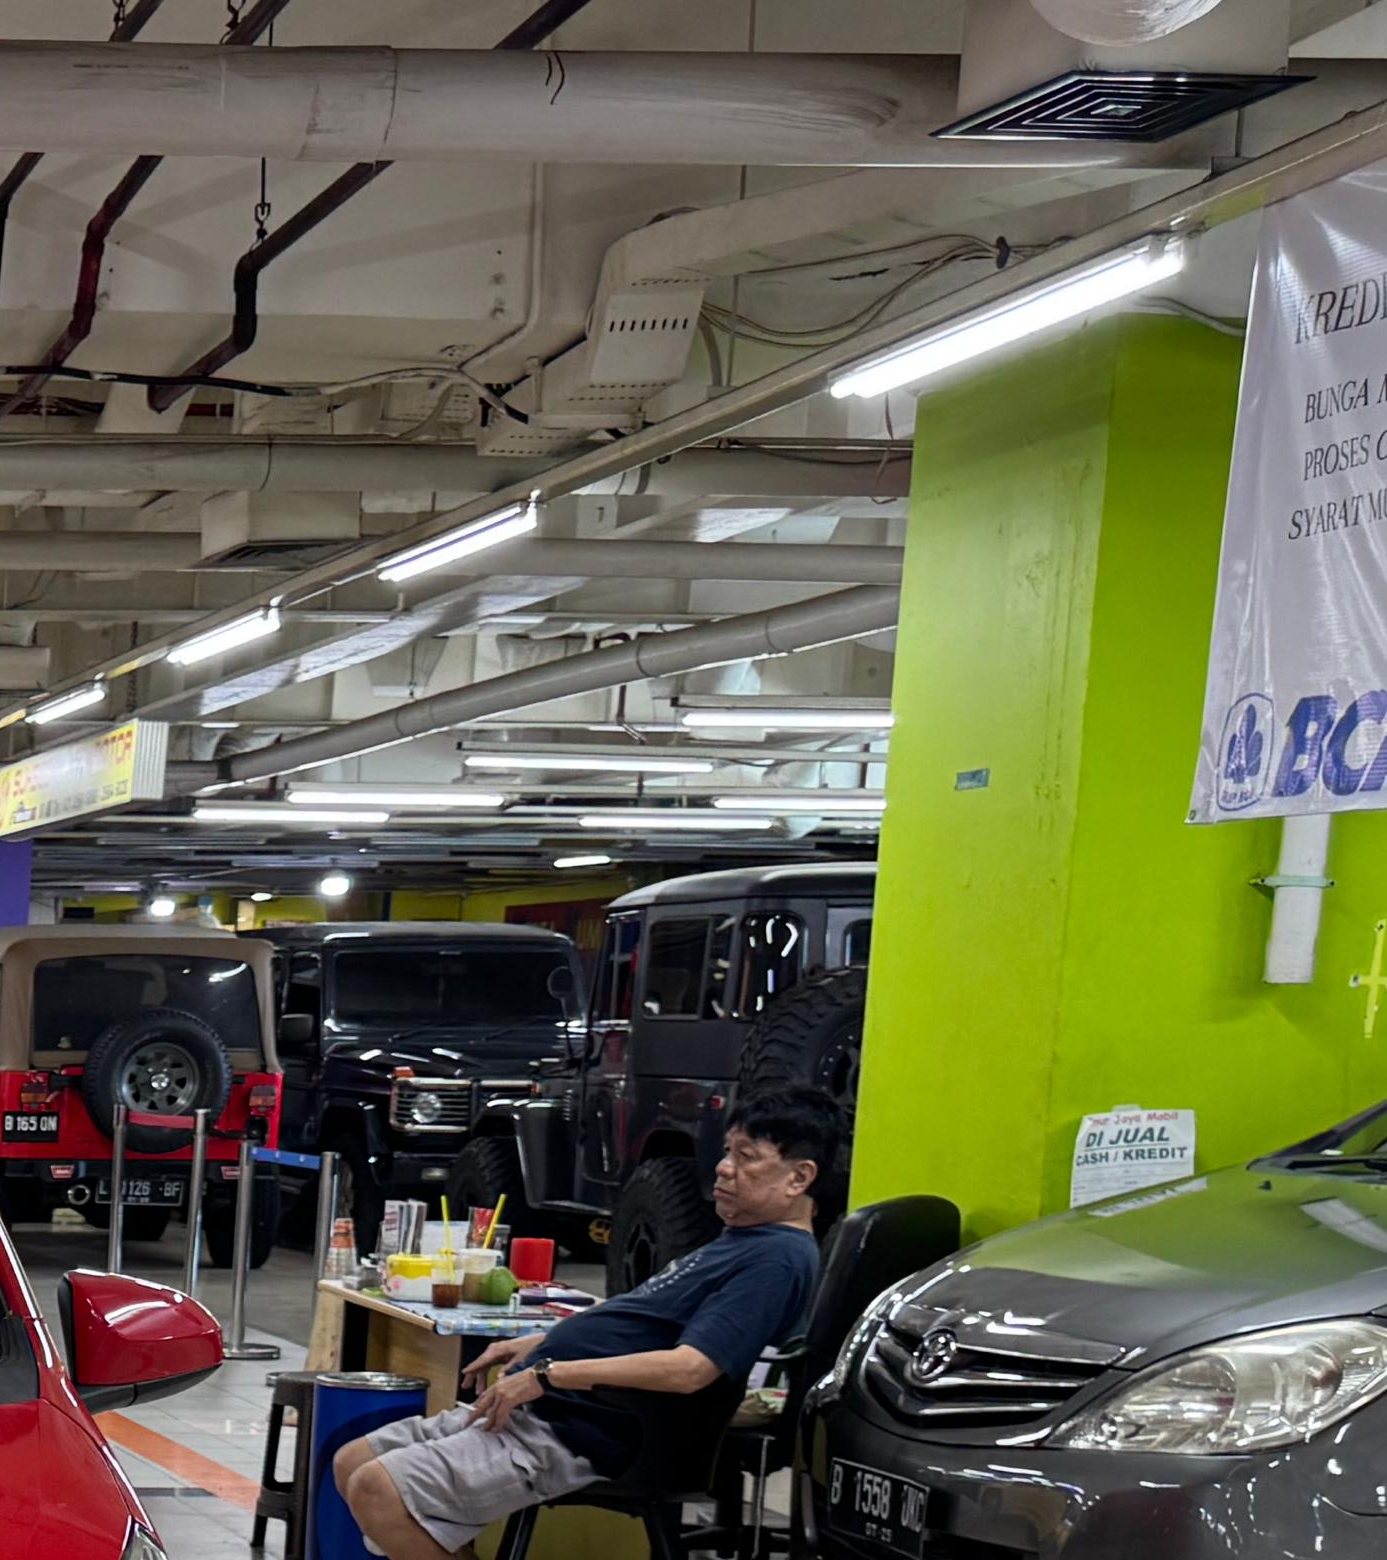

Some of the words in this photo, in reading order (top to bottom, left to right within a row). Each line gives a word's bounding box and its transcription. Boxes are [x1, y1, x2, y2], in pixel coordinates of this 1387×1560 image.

[1304, 377, 1369, 424] BUNGA
[1303, 433, 1370, 481] PROSES
[1288, 494, 1364, 540] SYARAT
[4, 1116, 13, 1131] B
[16, 1116, 37, 1131] 165
[1114, 1114, 1141, 1125] Jaya
[1146, 1112, 1179, 1121] Mobil
[1086, 1131, 1104, 1147] DI
[1109, 1126, 1170, 1145] JUAL
[1076, 1152, 1109, 1167] CASH
[1122, 1147, 1188, 1161] KREDIT
[831, 1464, 843, 1505] B
[854, 1471, 892, 1520] 1558
